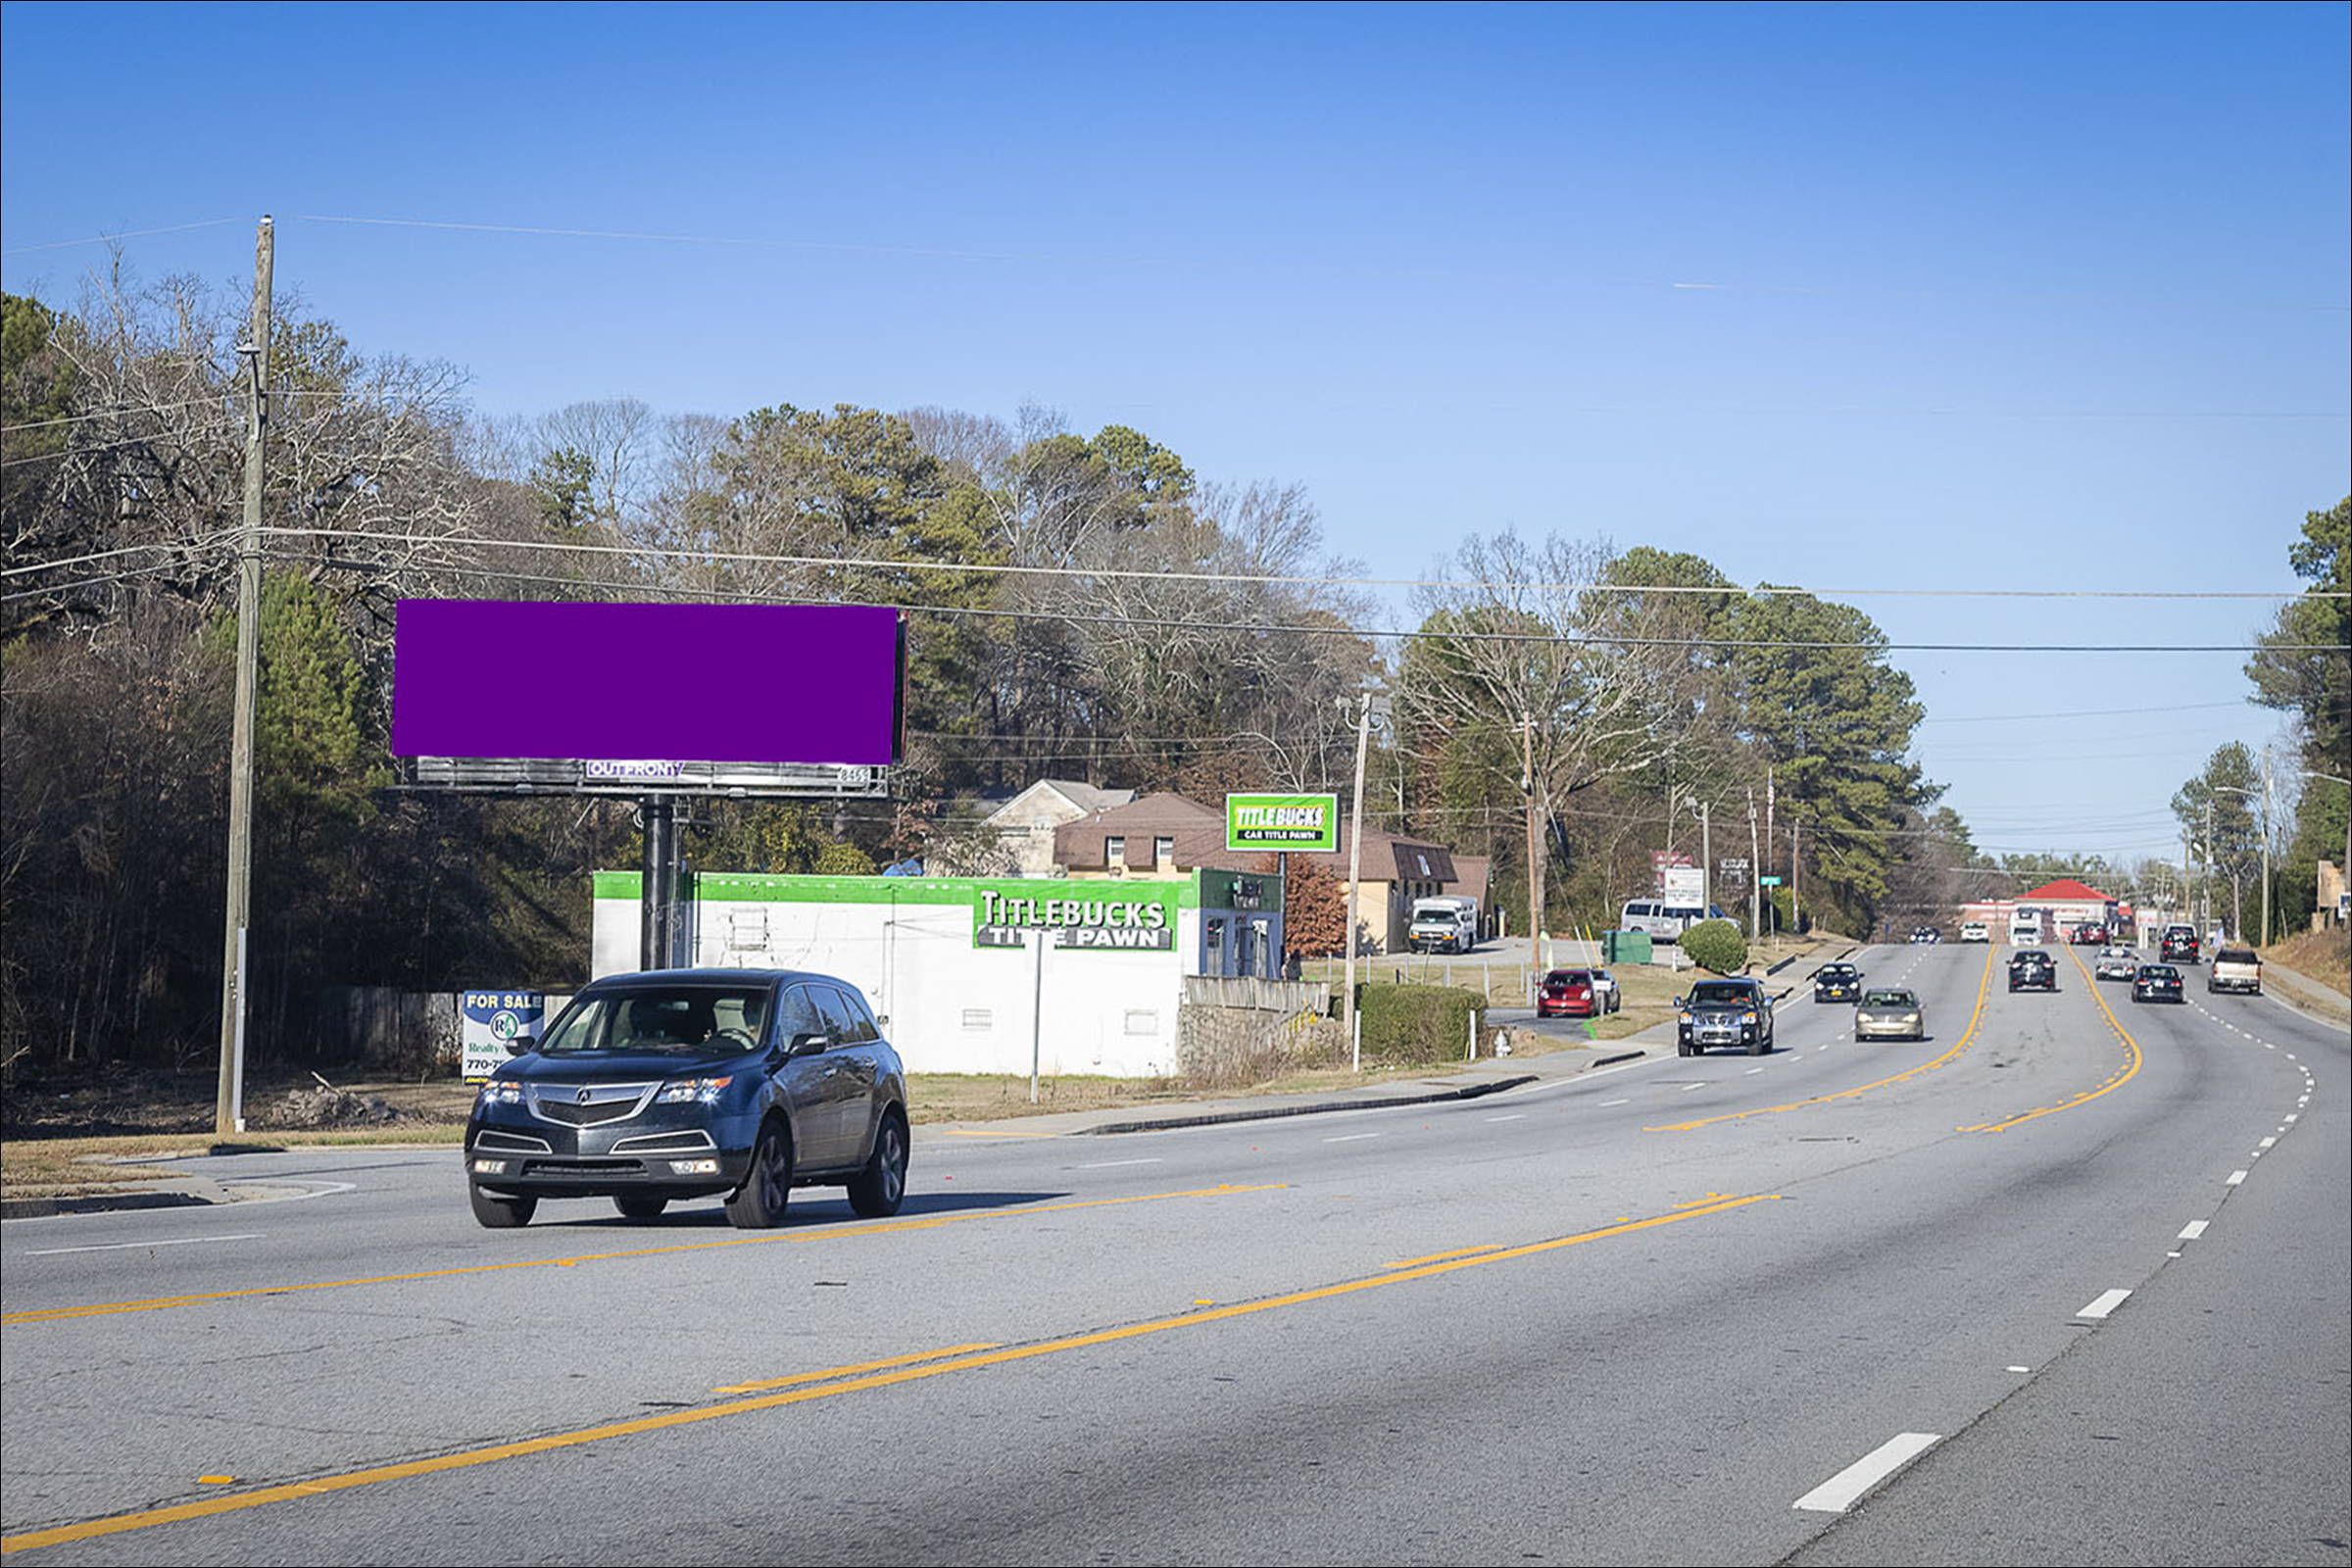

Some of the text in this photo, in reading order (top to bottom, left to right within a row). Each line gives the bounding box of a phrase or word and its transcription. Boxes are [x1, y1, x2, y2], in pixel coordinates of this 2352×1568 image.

[1244, 831, 1316, 840] CAR TITLE PAWN
[980, 889, 1166, 929] TITLEBUCKS
[1076, 929, 1159, 948] PAWN
[466, 995, 543, 1008] FOR SALE
[468, 1042, 499, 1054] Realty
